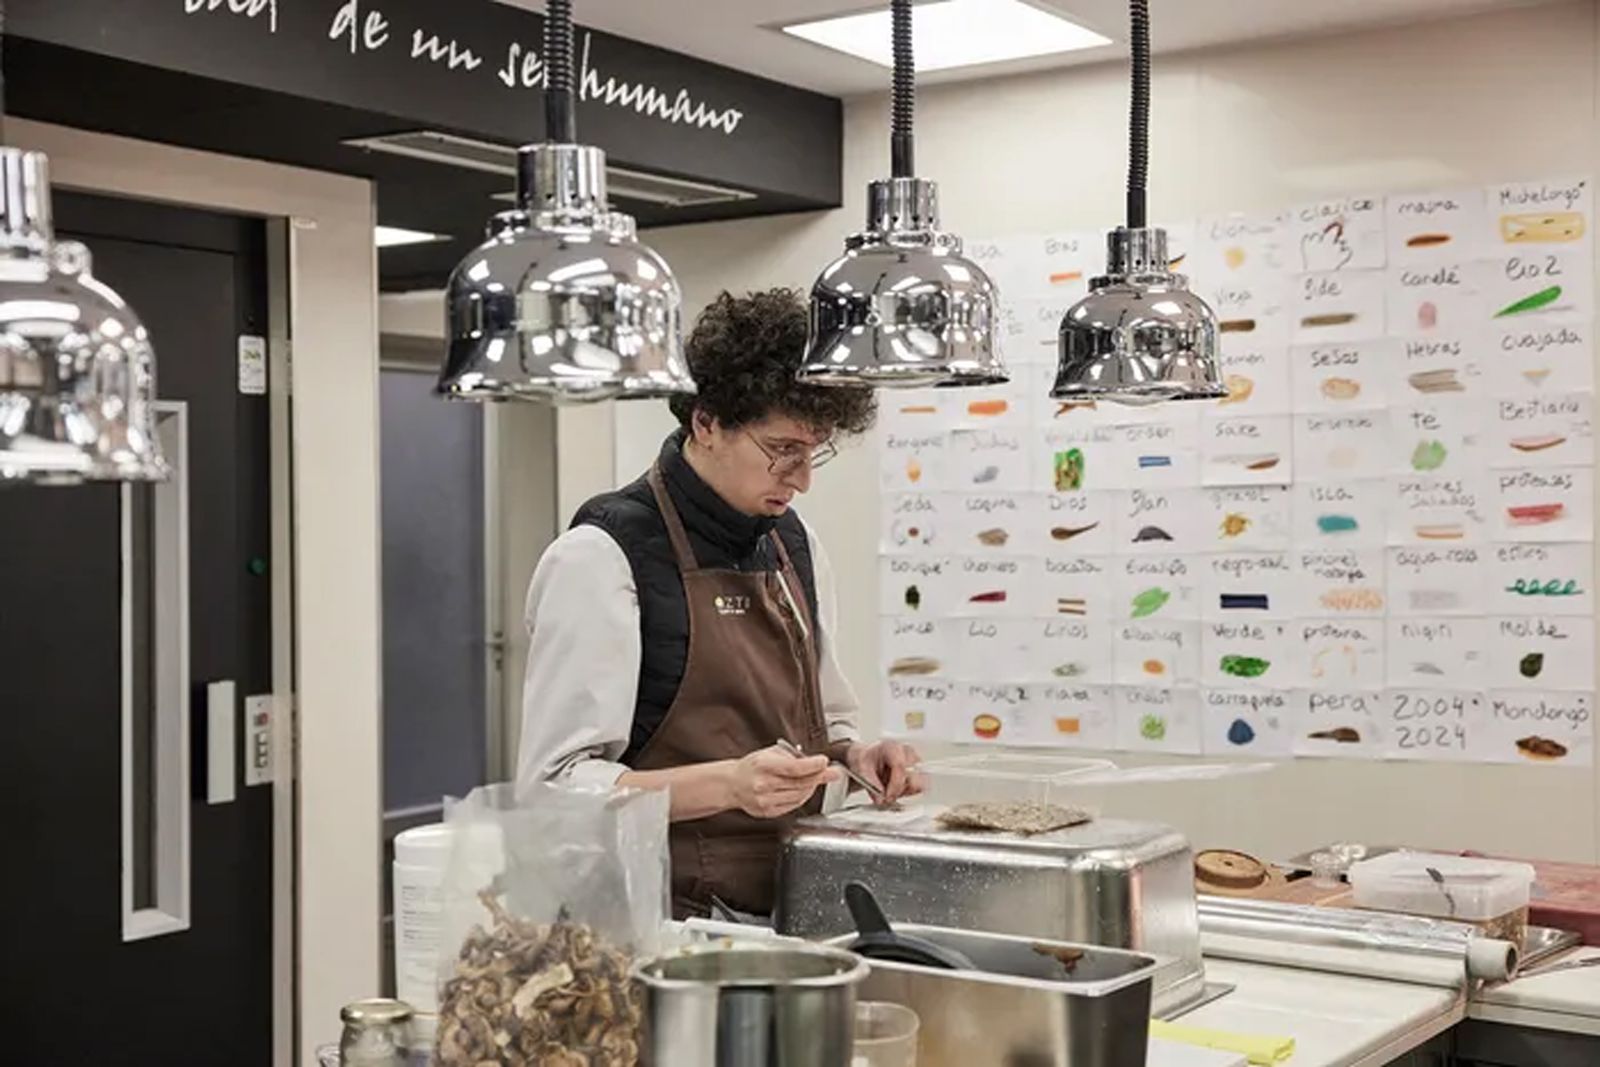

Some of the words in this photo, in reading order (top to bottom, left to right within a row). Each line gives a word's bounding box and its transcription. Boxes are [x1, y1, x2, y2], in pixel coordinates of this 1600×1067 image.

[579, 31, 744, 134] humano
[1544, 254, 1562, 275] 2
[1393, 694, 1465, 721] 2004
[1395, 724, 1467, 750] 2024
